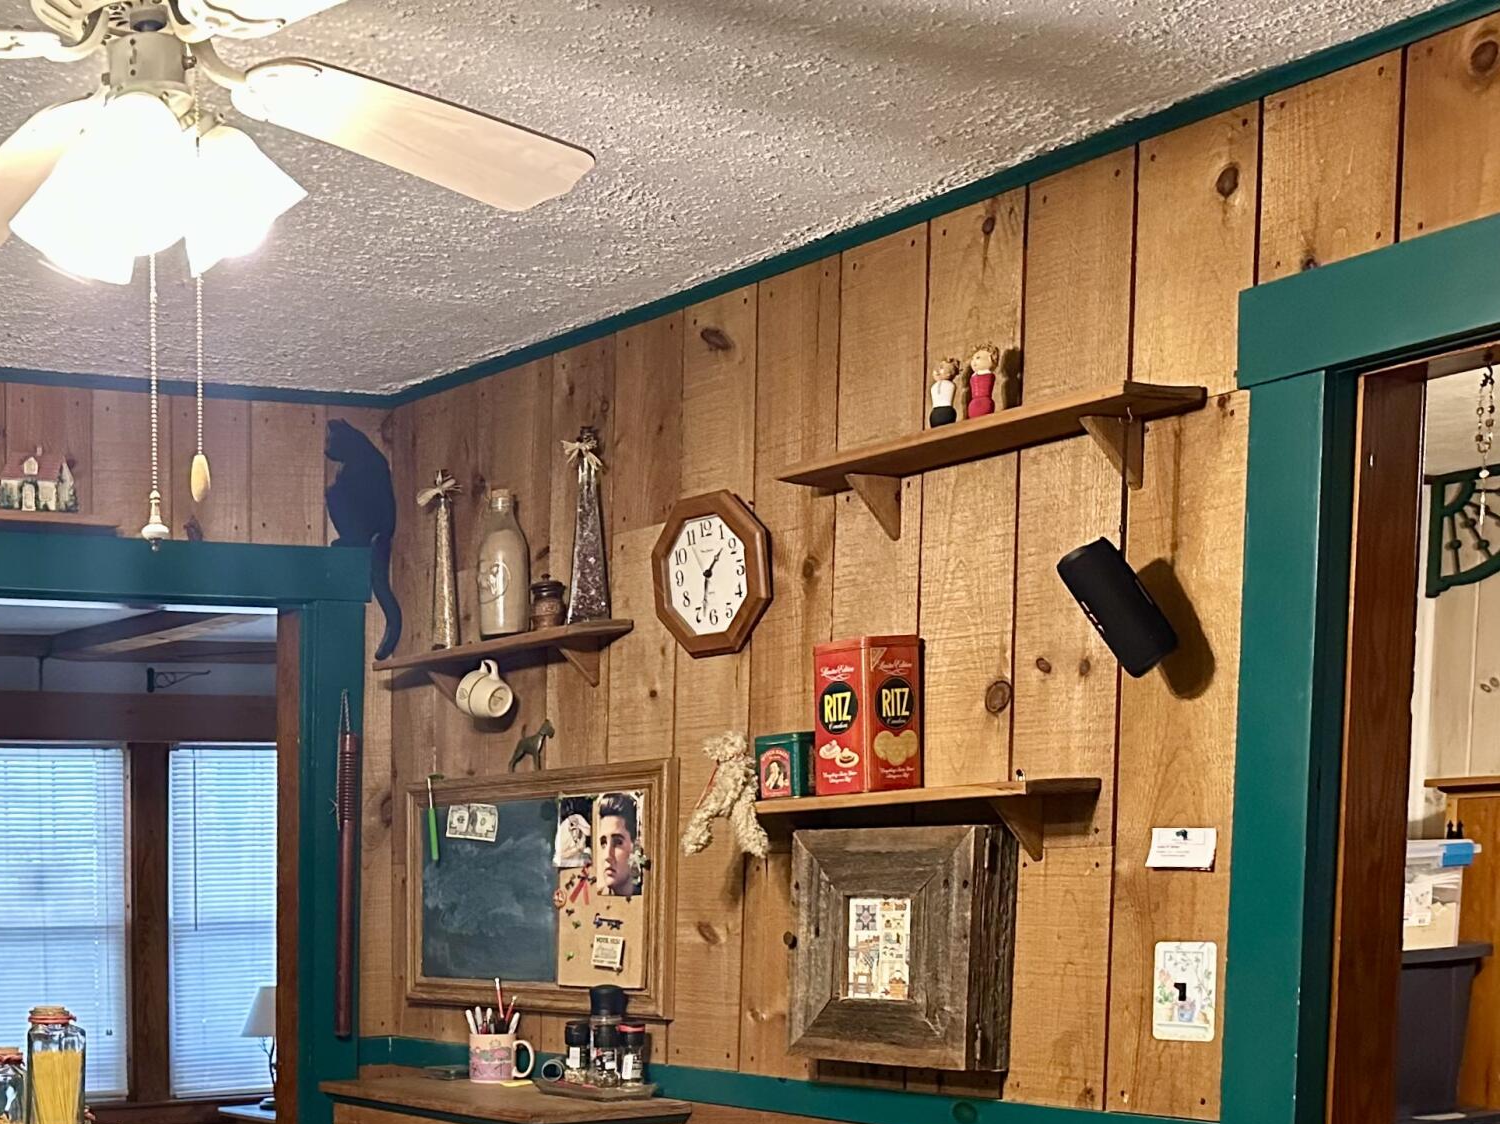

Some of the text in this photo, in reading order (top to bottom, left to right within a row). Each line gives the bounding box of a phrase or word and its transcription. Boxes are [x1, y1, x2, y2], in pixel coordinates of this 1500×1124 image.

[700, 520, 713, 538] 12
[687, 530, 696, 546] 11
[728, 537, 737, 555] 2
[675, 548, 687, 566] 10
[736, 559, 745, 576] 3
[675, 570, 684, 587] 9
[735, 583, 743, 598] 4
[683, 591, 690, 608] 8
[695, 607, 702, 624] 7
[709, 609, 718, 625] 6
[725, 602, 733, 618] 5
[824, 691, 852, 723] RITZ
[882, 688, 910, 717] RITZ
